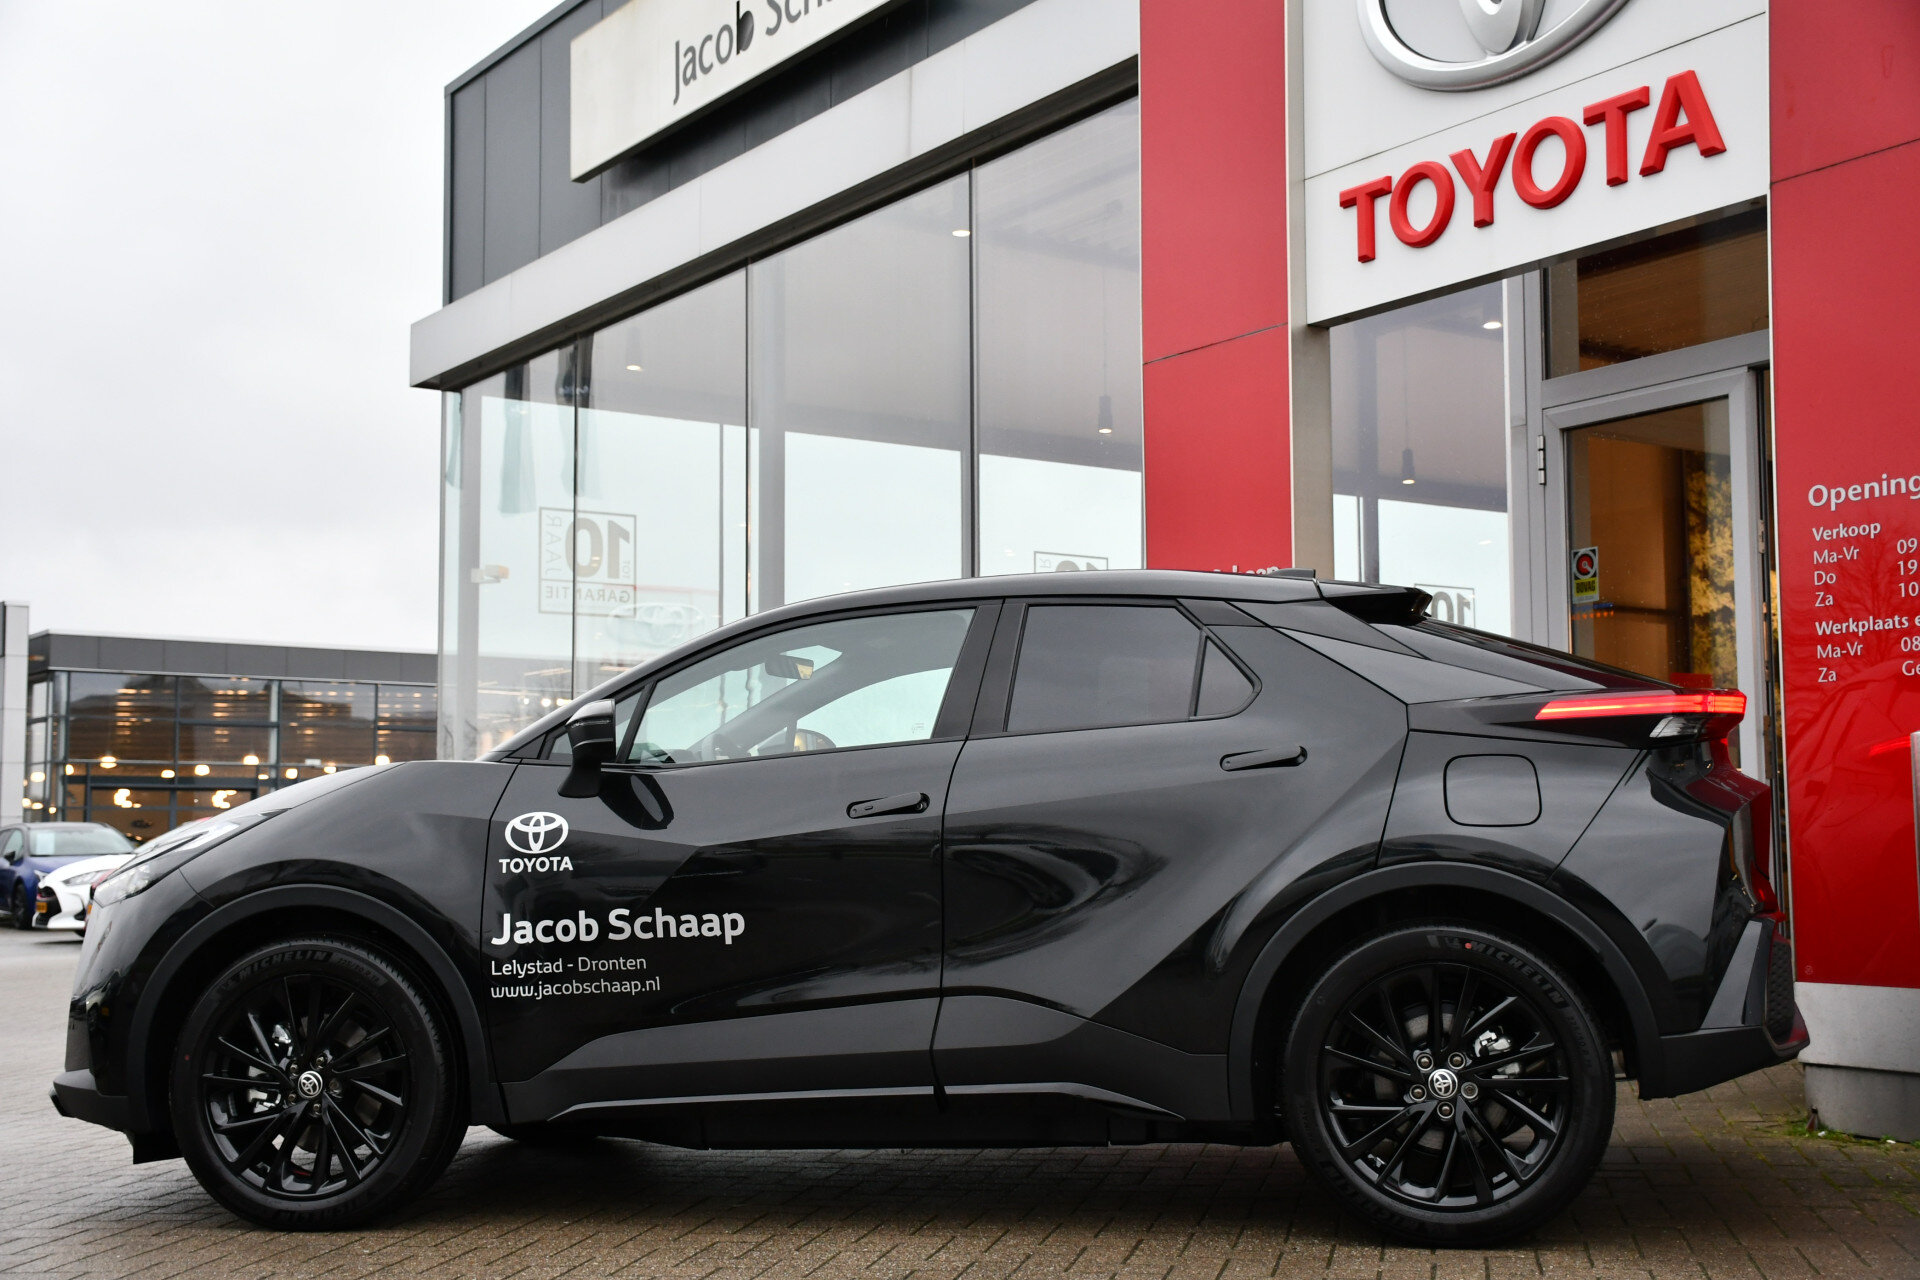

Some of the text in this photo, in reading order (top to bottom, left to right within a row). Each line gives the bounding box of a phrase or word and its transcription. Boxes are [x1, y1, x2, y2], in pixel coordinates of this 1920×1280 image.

[673, 0, 754, 105] Jacob
[1339, 69, 1727, 264] TOYOTA
[1808, 473, 1920, 511] Opening
[1812, 522, 1881, 541] Verkoop
[1813, 538, 1918, 565] Ma-Vr 09
[1814, 560, 1918, 586] Do 19
[1815, 582, 1919, 607] Za 10
[1815, 615, 1909, 637] Werkplaats
[1817, 636, 1920, 659] Ma-Vr 08
[1817, 667, 1837, 683] Za
[499, 856, 574, 873] TOYOTA
[491, 907, 745, 945] Jacob Schaap
[491, 958, 563, 978] Lelystad
[578, 956, 647, 973] Dronten
[491, 976, 661, 1000] www.jacobschaap.nl
